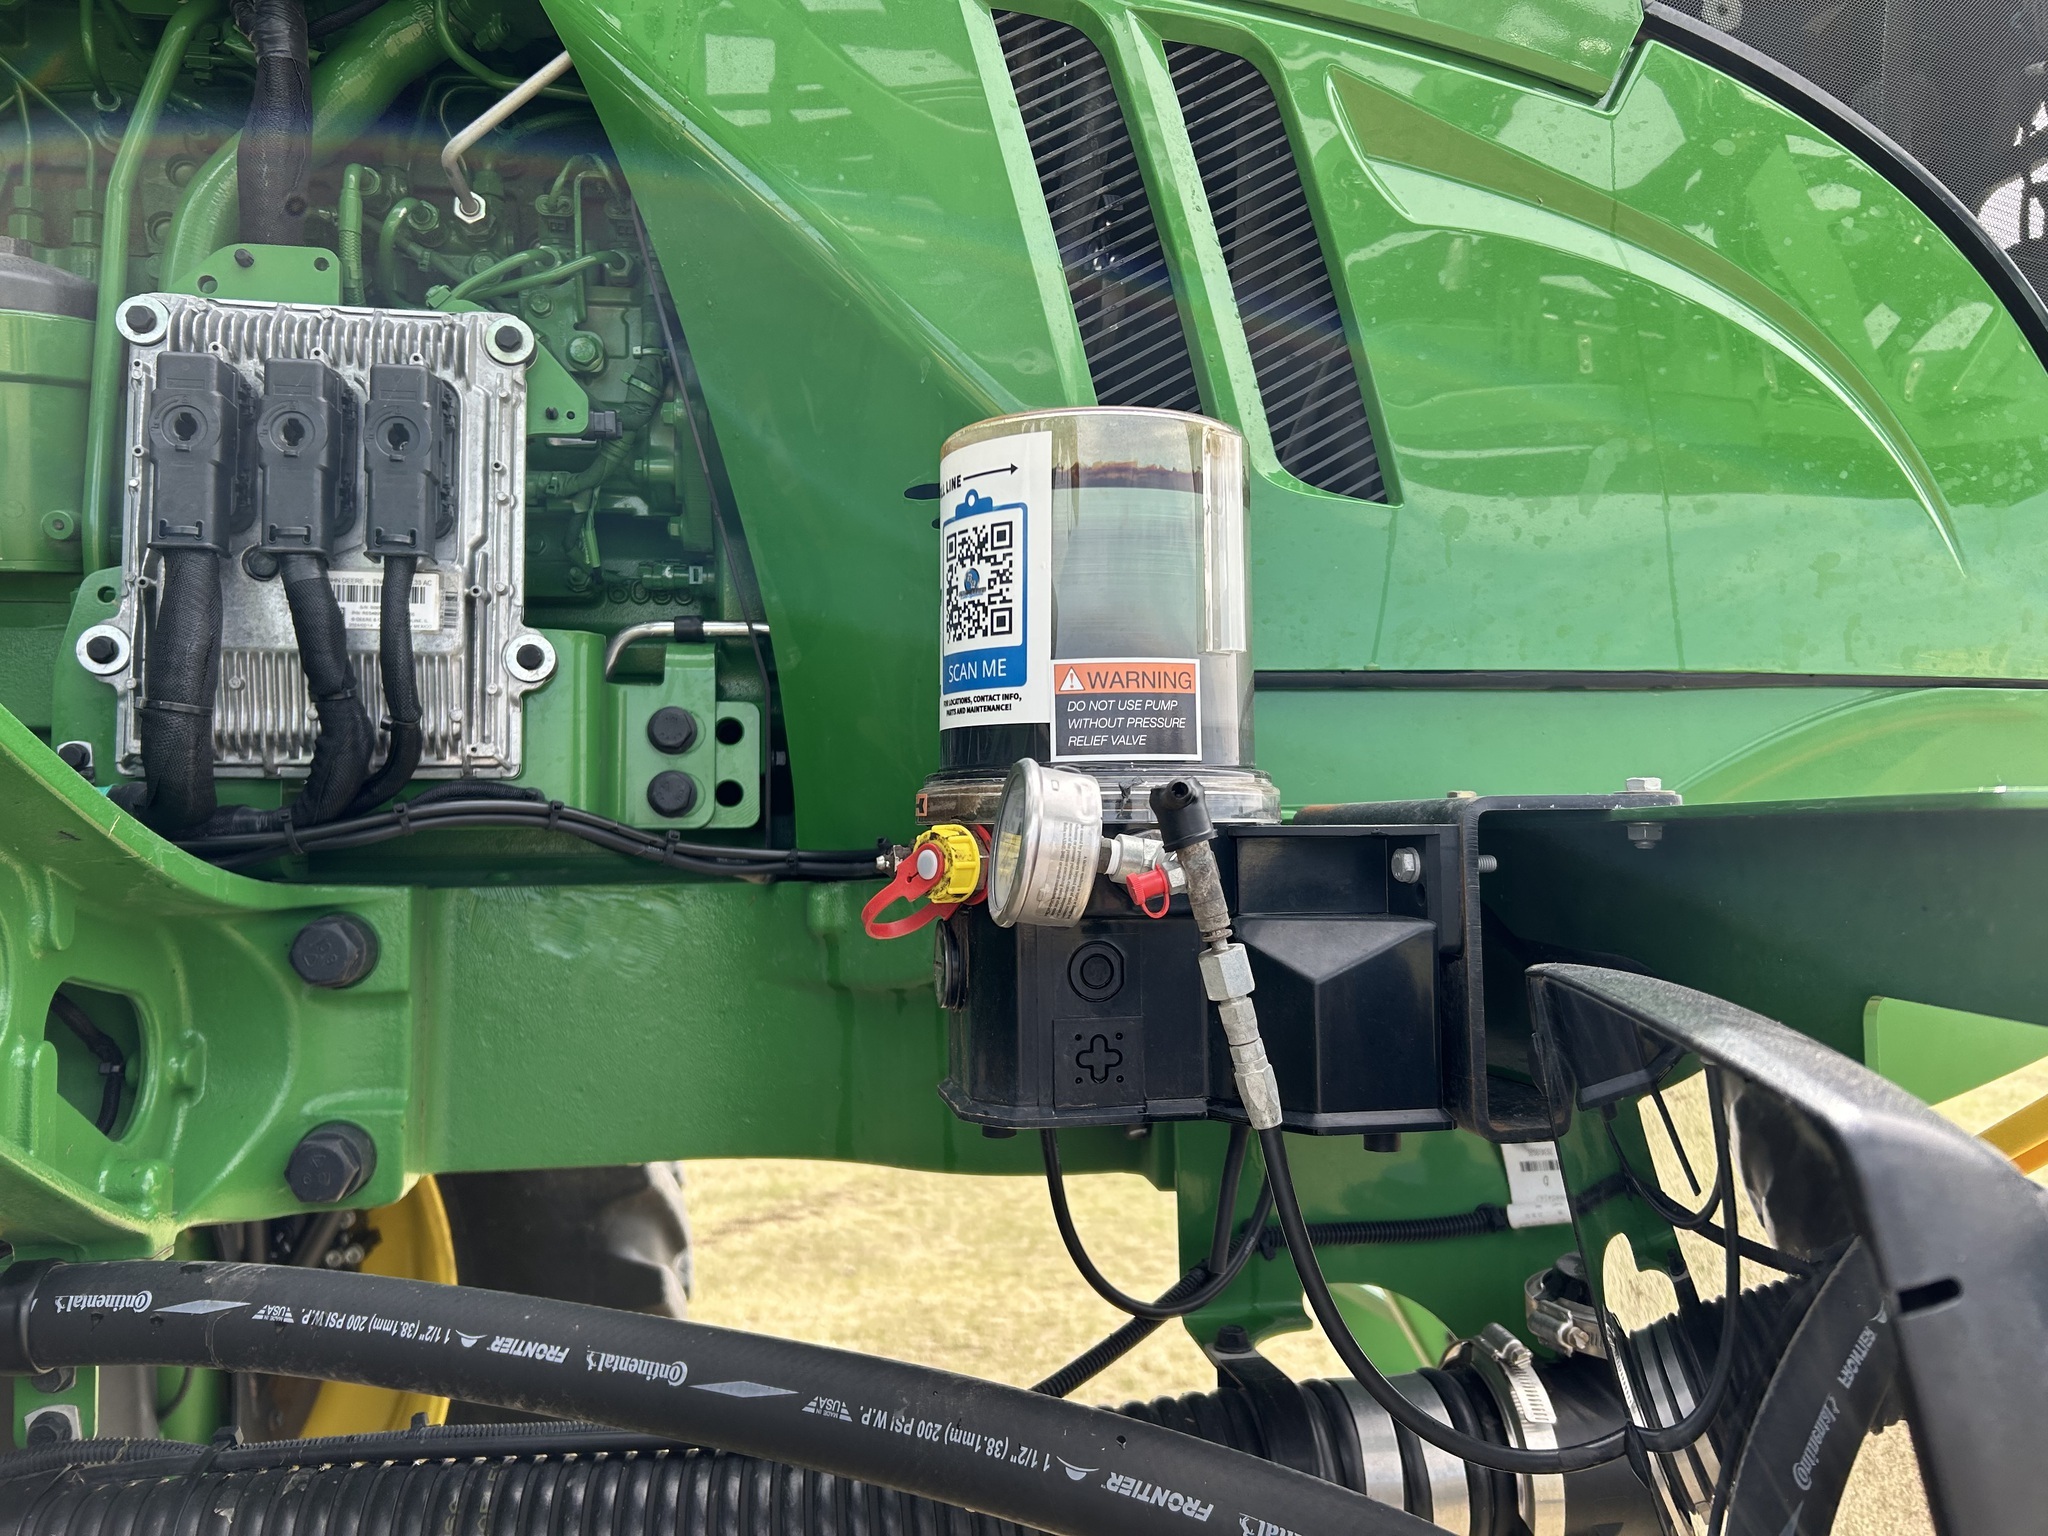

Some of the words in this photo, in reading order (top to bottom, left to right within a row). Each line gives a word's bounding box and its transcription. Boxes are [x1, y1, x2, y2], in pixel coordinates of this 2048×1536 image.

[946, 474, 962, 494] LINE
[948, 661, 977, 683] SCAN
[982, 658, 1007, 678] ME
[1087, 671, 1192, 690] WARNING
[949, 696, 972, 706] LOCATIONS,
[973, 693, 1001, 703] CONTACT
[1002, 692, 1022, 702] INFO,
[966, 703, 1012, 714] MAINTENANCE!
[1067, 701, 1086, 712] DO
[1088, 700, 1116, 711] NOT
[1117, 700, 1142, 711] USE
[1144, 700, 1178, 711] PUMP
[1068, 718, 1125, 729] WITHOUT
[1126, 717, 1187, 729] PRESSURE
[1068, 735, 1109, 746] RELIEF
[1111, 734, 1147, 746] VALVE
[65, 1290, 152, 1313] Continental
[267, 1305, 287, 1316] USA
[301, 1308, 325, 1326] W.P.
[324, 1311, 345, 1329] PSI
[346, 1314, 369, 1332] 200
[368, 1313, 421, 1340] (38.1mm)
[419, 1324, 442, 1343] 1/2"
[443, 1328, 451, 1344] 1
[490, 1335, 570, 1365] FRONTIER
[597, 1352, 688, 1387] Continental
[819, 1396, 841, 1413] USA
[823, 1409, 839, 1419] MADE
[859, 1405, 888, 1430] W.P.
[890, 1415, 914, 1436] PSI
[916, 1420, 942, 1442] 200
[944, 1421, 1009, 1460] (38.1mm)
[1010, 1444, 1038, 1469] 1/2"
[1043, 1453, 1050, 1472] 1
[1105, 1471, 1214, 1522] FRONTIER
